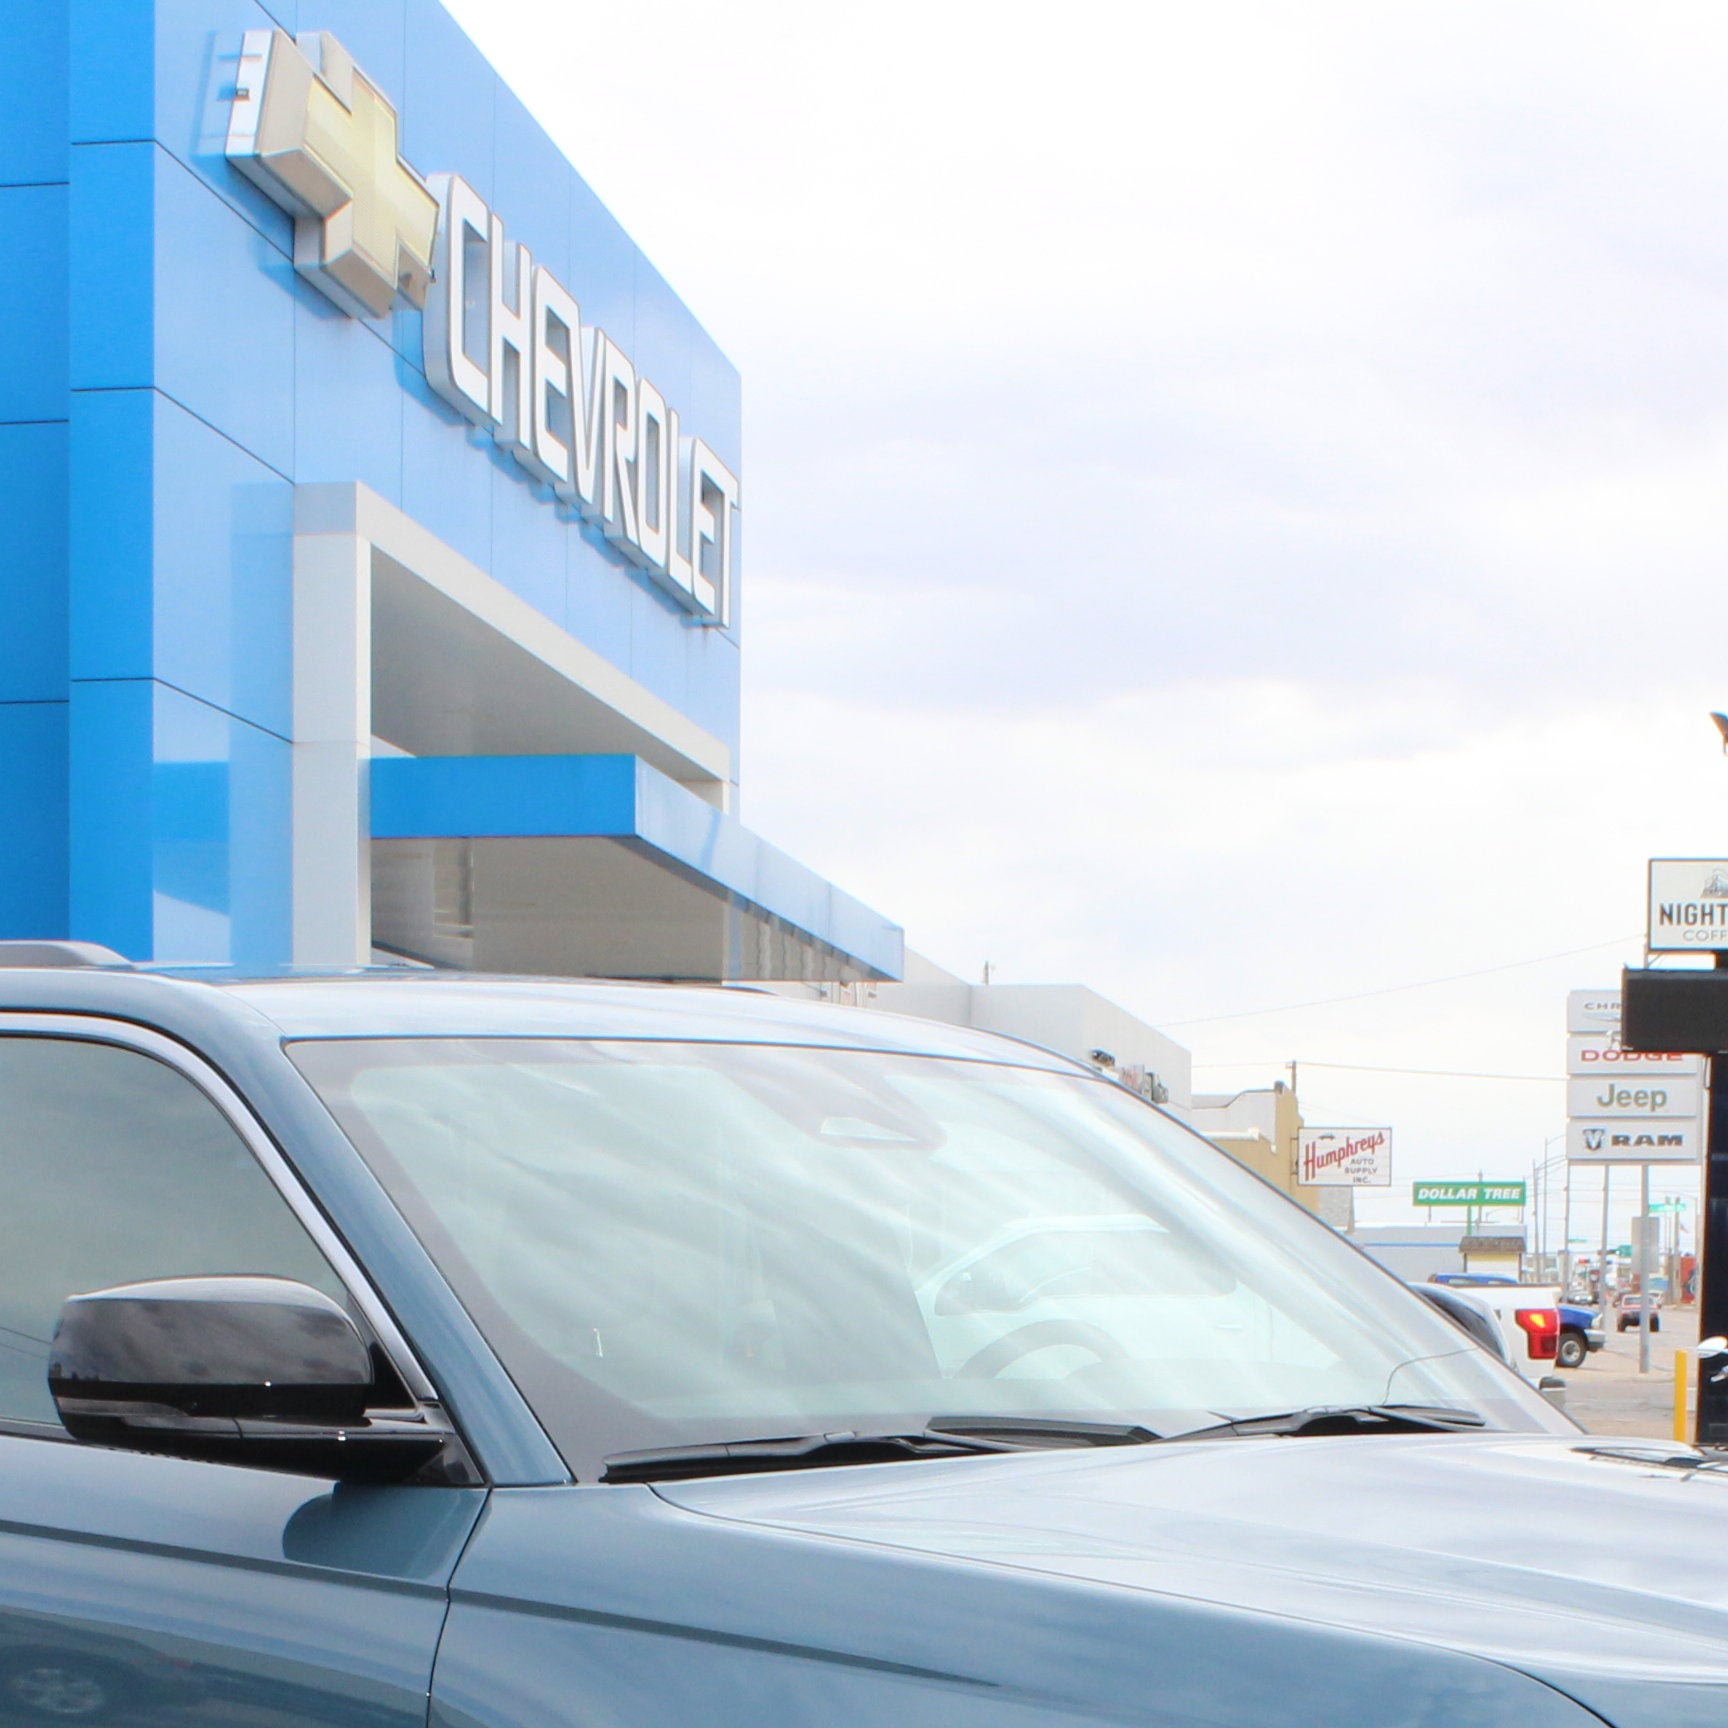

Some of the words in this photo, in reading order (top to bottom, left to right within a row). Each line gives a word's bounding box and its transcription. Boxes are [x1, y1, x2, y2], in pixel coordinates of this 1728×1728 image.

[424, 173, 738, 628] CHEVROLET
[1659, 903, 1727, 926] NIGHT
[1596, 1084, 1668, 1111] Jeep
[1611, 1134, 1684, 1147] RAM
[1304, 1131, 1385, 1181] Humphreys
[1350, 1157, 1375, 1166] AUTO
[1344, 1166, 1378, 1175] SUPPLY
[1417, 1187, 1478, 1200] DOLLAR
[1483, 1187, 1521, 1200] TREE
